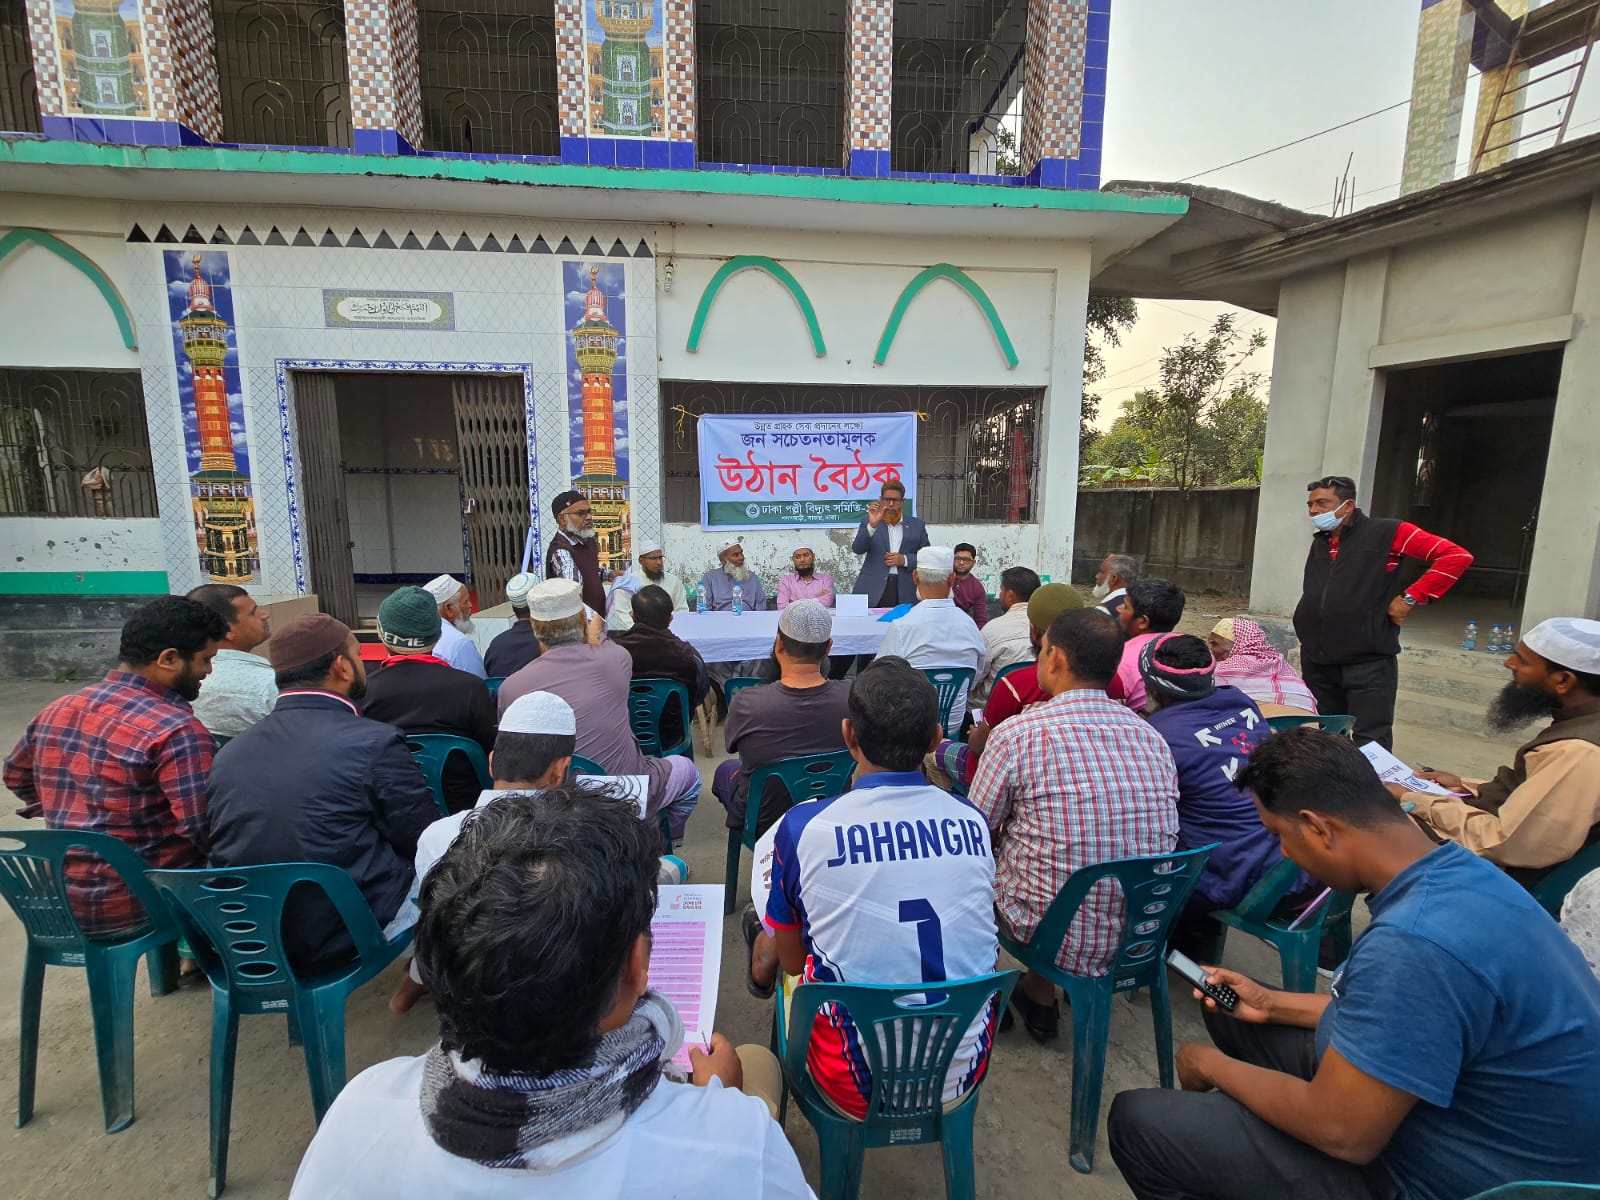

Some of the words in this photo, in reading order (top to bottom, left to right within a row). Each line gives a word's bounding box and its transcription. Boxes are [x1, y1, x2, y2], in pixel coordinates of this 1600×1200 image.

[754, 421, 772, 432] উন্নত
[774, 422, 793, 431] গ্রাহক
[796, 422, 812, 431] সেবা
[814, 422, 841, 430] প্রদানের
[741, 432, 767, 449] জন
[771, 431, 877, 452] সচেতনতামূলক
[714, 450, 803, 495] উঠান
[809, 449, 904, 496] বৈঠক
[761, 504, 783, 515] ঢাকা
[785, 501, 802, 515] পল্লী
[805, 501, 831, 514] বিদ্যুৎ
[378, 626, 424, 647] EME
[1214, 718, 1236, 730] WINER
[827, 818, 987, 868] JAHANGIR
